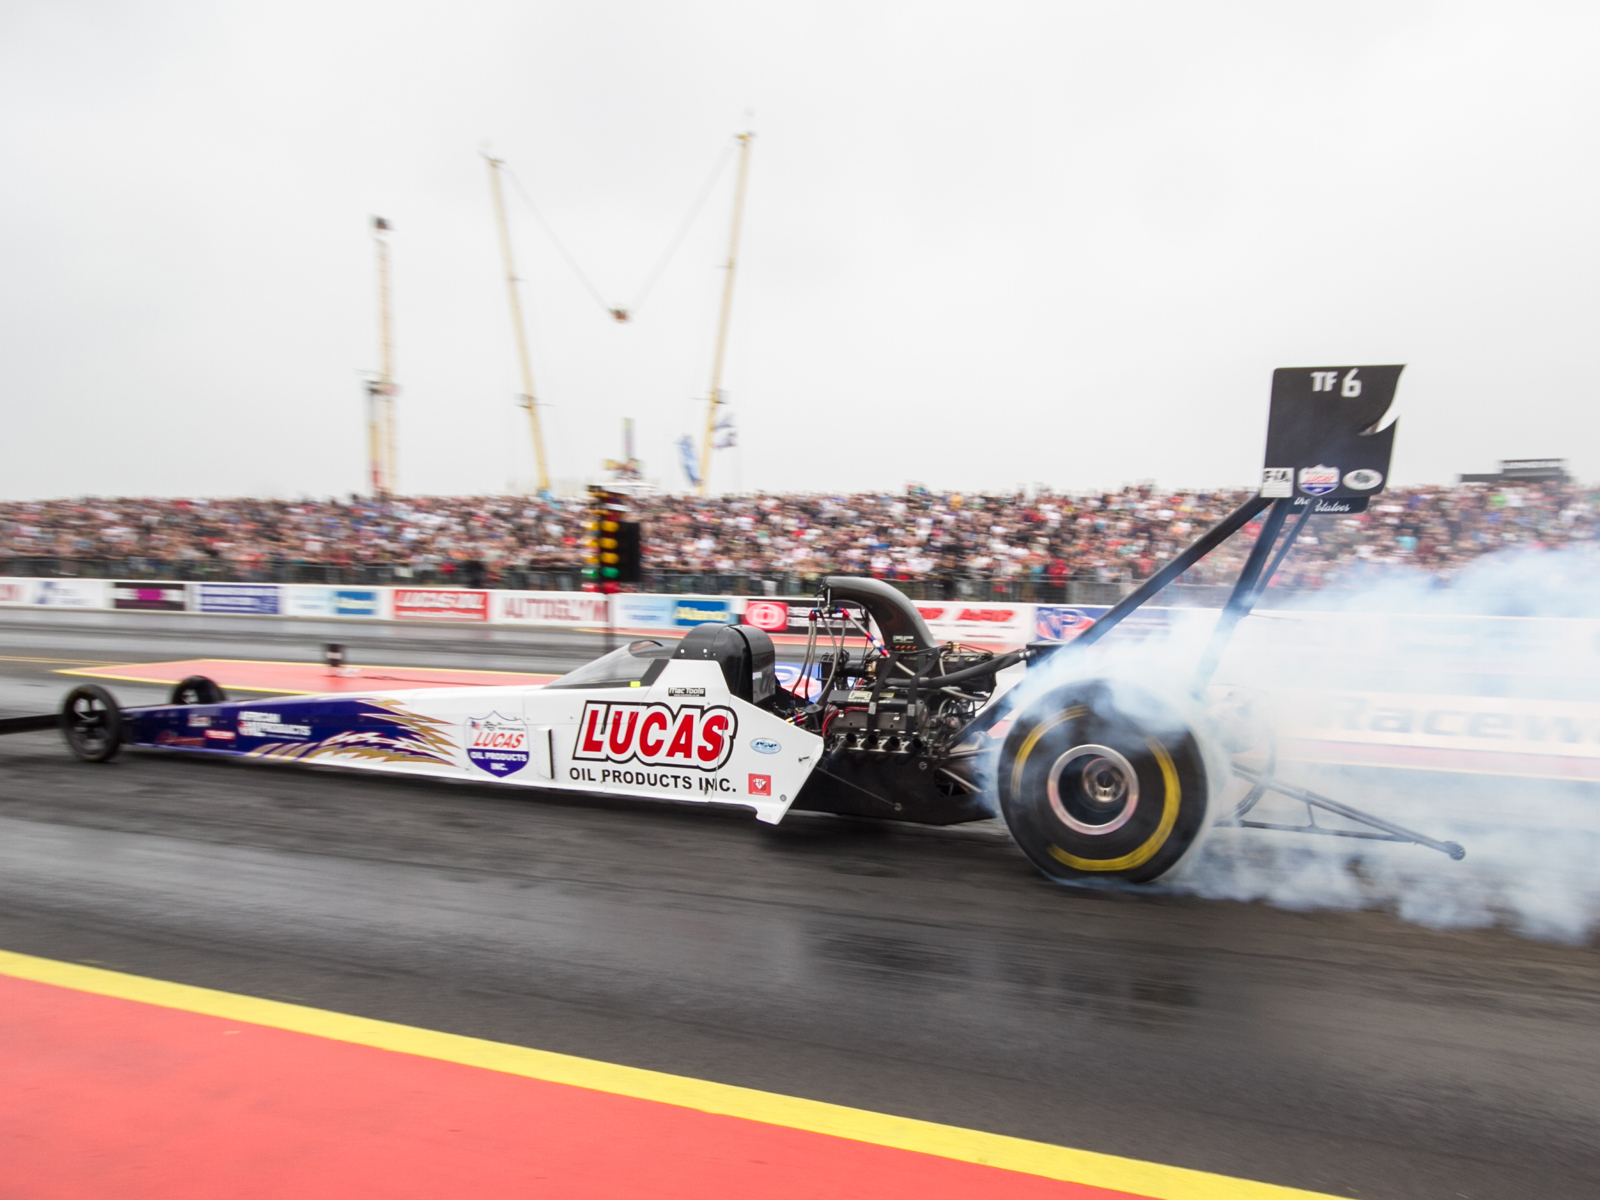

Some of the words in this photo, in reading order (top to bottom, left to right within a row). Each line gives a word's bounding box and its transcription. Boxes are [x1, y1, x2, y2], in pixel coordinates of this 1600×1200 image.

[1310, 371, 1338, 392] TF
[1341, 367, 1362, 398] 6
[473, 731, 524, 749] LUCAS
[580, 707, 731, 764] LUCAS
[470, 751, 485, 760] OIL
[485, 752, 527, 762] PRODUCTS
[569, 767, 596, 782] OIL
[602, 769, 692, 789] PRODUCTS
[699, 777, 737, 793] INC.
